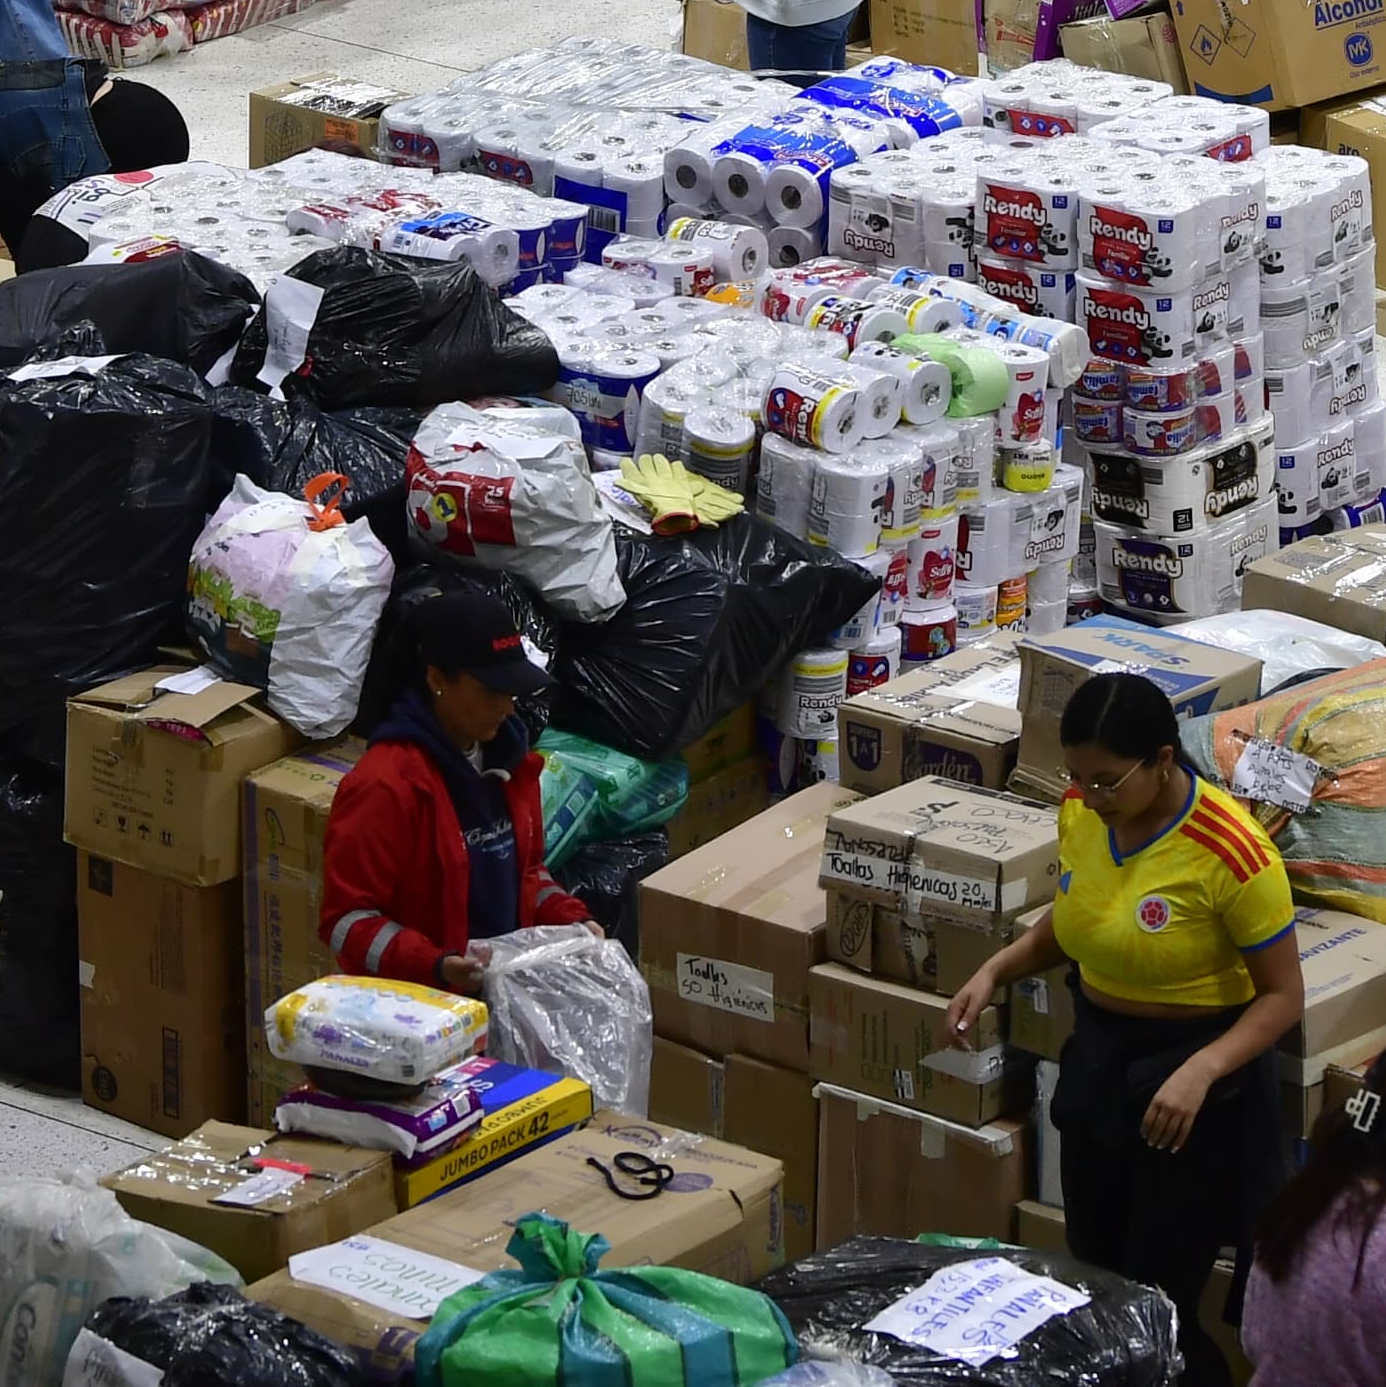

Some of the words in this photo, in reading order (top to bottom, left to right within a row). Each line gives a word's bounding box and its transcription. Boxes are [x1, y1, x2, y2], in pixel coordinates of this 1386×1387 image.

[1347, 39, 1370, 59] MK
[984, 194, 1047, 227] Rendy
[1054, 196, 1066, 206] 12
[1330, 191, 1365, 223] Rendy
[1159, 220, 1172, 231] 12
[1221, 203, 1259, 231] Rendy
[1268, 216, 1280, 228] 12
[844, 229, 895, 259] Rendy
[1090, 216, 1153, 251] Rendy
[979, 270, 1038, 305] Rendy
[1042, 275, 1054, 285] 12
[1157, 298, 1171, 310] 12
[1192, 281, 1232, 312] Rendy
[1084, 298, 1151, 330] Rendy
[1329, 386, 1366, 417] Rendy
[1317, 438, 1354, 469] Rendy
[487, 485, 504, 498] 25
[1092, 490, 1149, 521] Rendy
[1205, 480, 1259, 516] Rendy
[1024, 532, 1065, 559] Rendy
[1230, 525, 1268, 555] Rendy
[1112, 550, 1183, 578] Rendy
[826, 851, 873, 881] Toallas
[439, 1146, 489, 1182] JUMBO
[489, 1128, 527, 1154] PACK
[528, 1111, 551, 1137] 42
